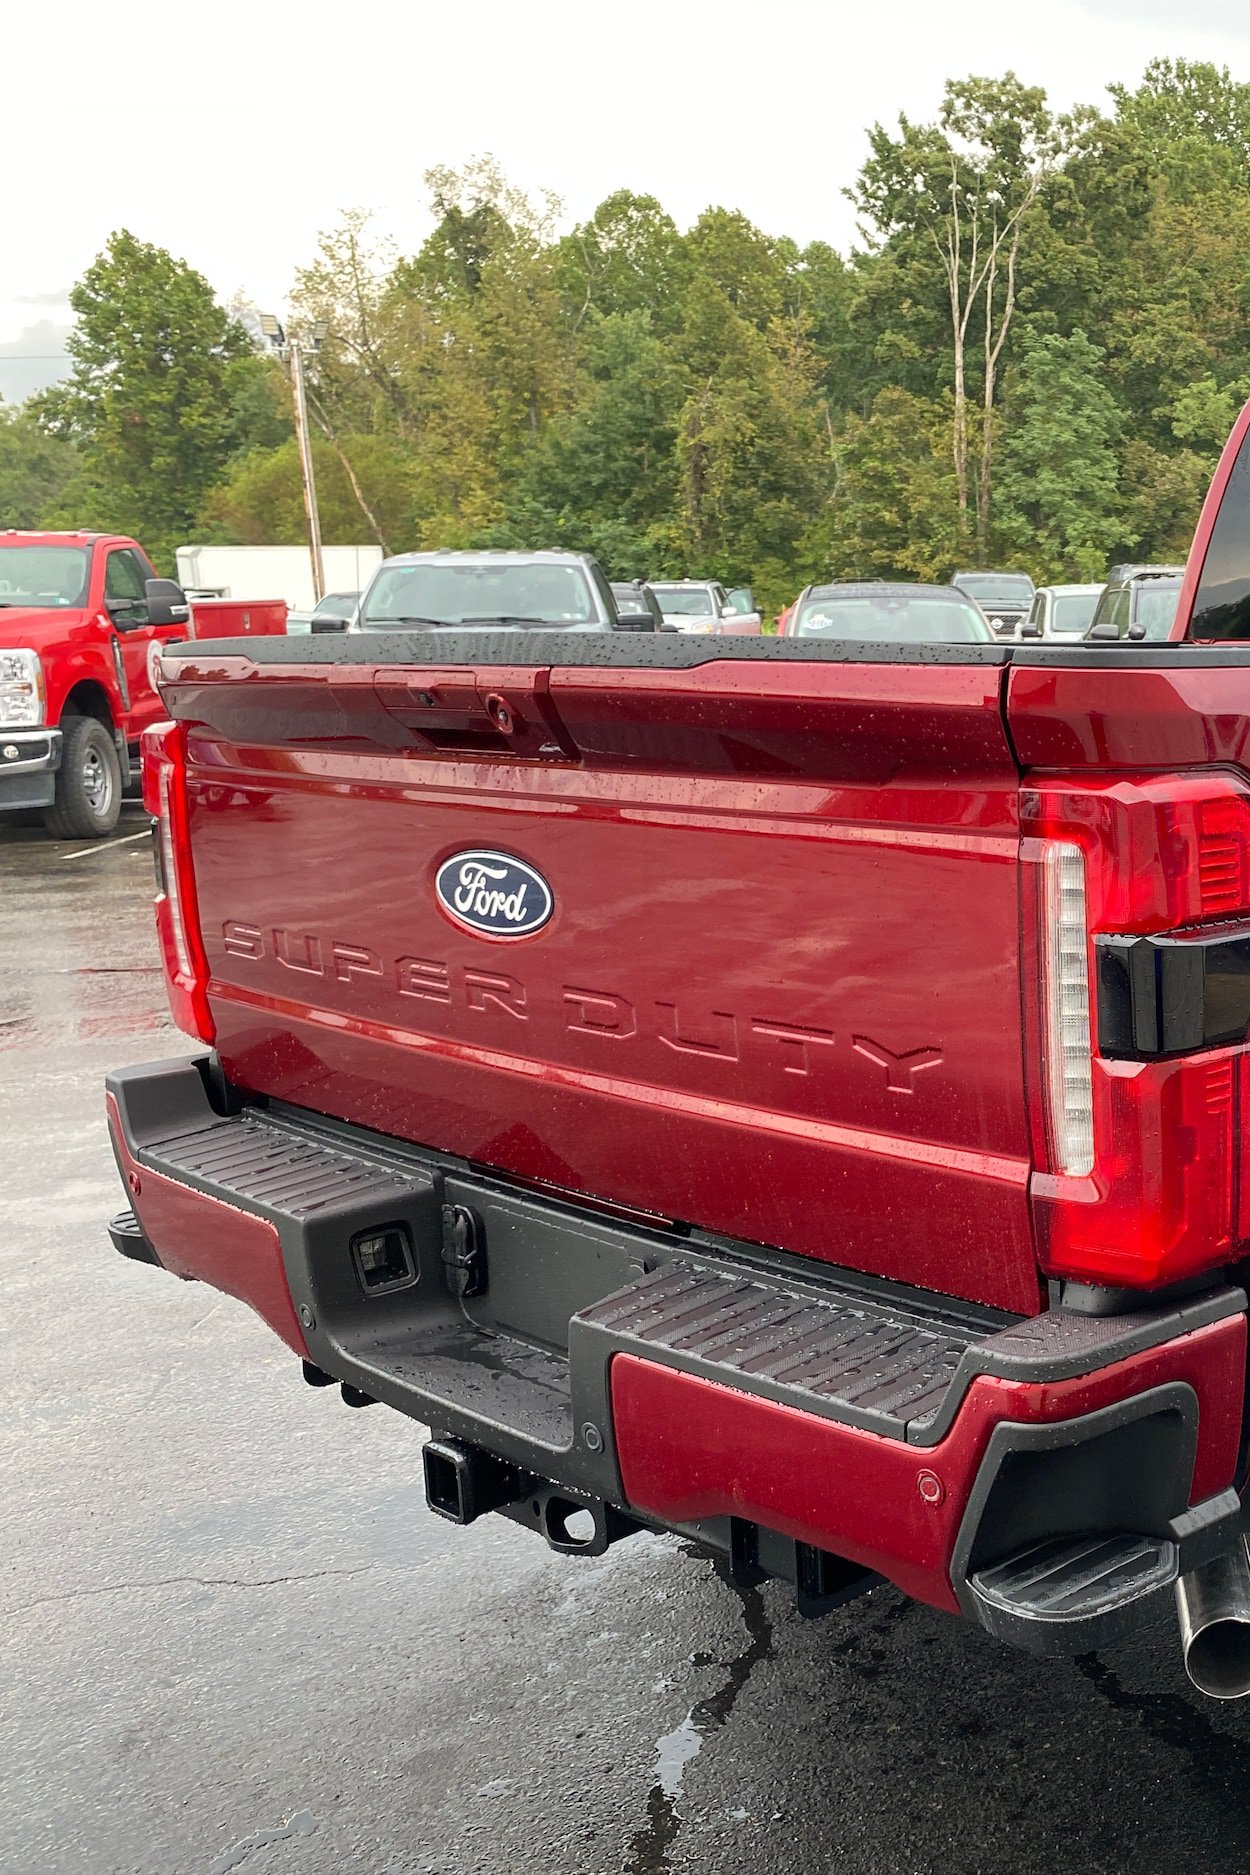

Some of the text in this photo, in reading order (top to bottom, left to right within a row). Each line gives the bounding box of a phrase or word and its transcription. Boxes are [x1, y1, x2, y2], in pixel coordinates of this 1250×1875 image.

[454, 861, 528, 922] Ford
[222, 917, 944, 1094] SUPER DUTY
